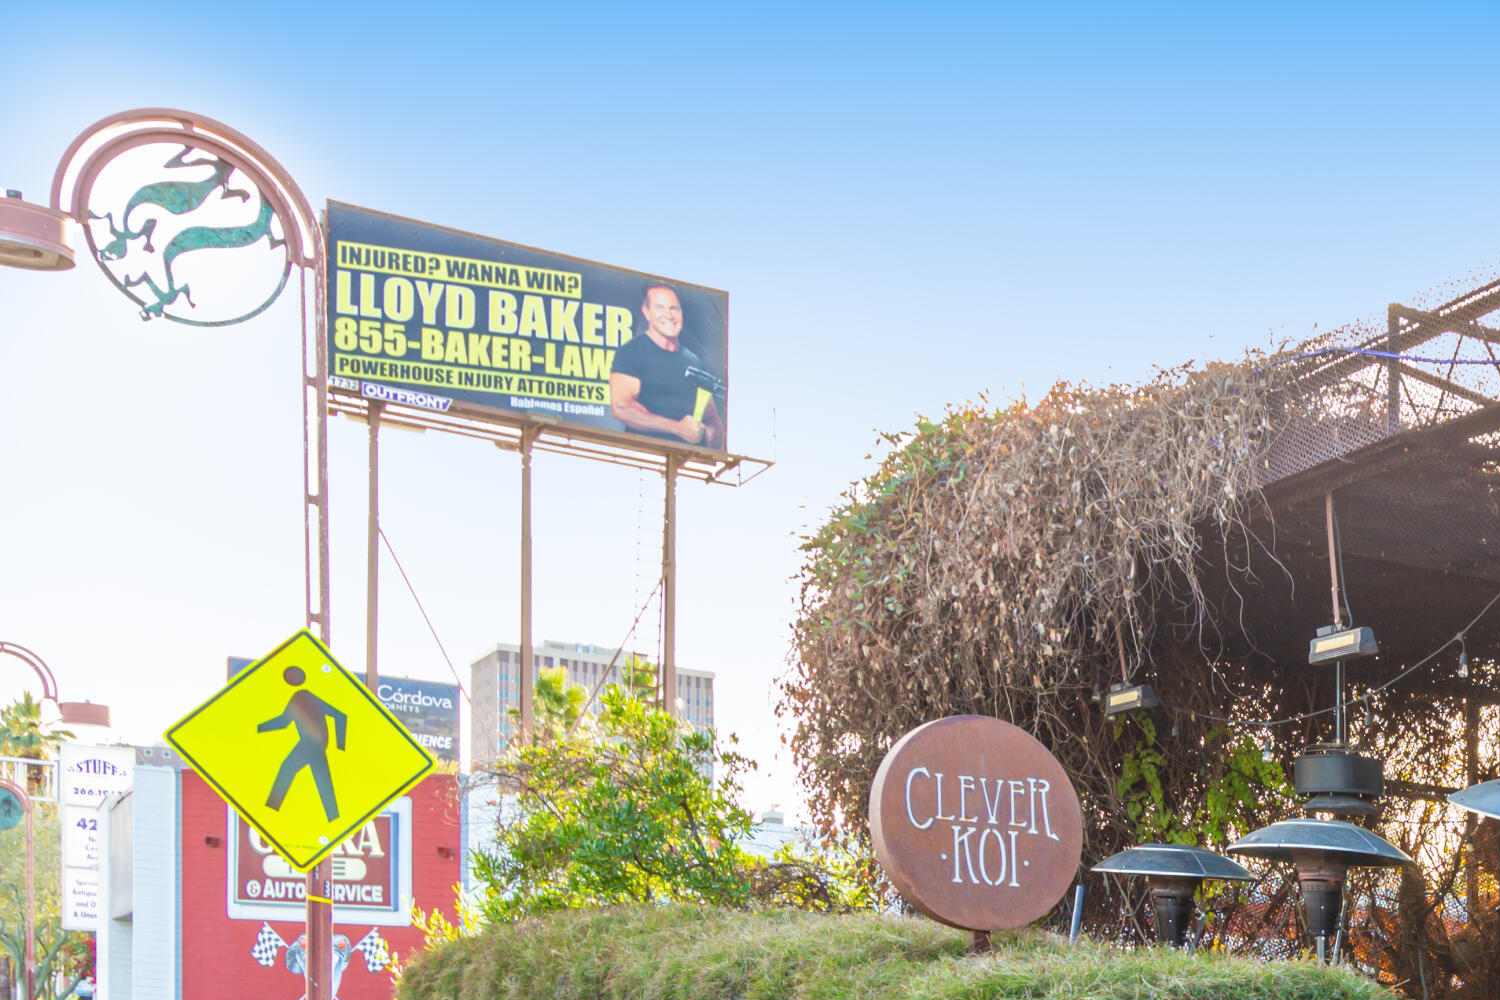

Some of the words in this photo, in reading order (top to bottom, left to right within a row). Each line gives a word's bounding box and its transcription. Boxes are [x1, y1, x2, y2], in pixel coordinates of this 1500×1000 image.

[340, 244, 440, 275] INJURED?
[445, 260, 519, 287] WANNA
[525, 271, 580, 294] WIN?
[336, 270, 476, 329] LLOYD
[488, 289, 633, 346] BAKER
[334, 317, 615, 380] 855-BAKER-LAW
[338, 357, 454, 384] POWERHOUSE
[458, 371, 514, 391] INJURY
[517, 378, 605, 401] ATTORNEYS
[364, 383, 448, 410] OUTFRONT
[510, 396, 562, 412] Hablamos
[563, 402, 605, 416] Español
[377, 684, 453, 709] Córdova
[384, 702, 420, 713] ORNEYS
[905, 766, 1060, 841] CLEVER
[951, 825, 1021, 887] KOI
[263, 879, 306, 899] AUTO
[334, 884, 383, 903] RVICE
